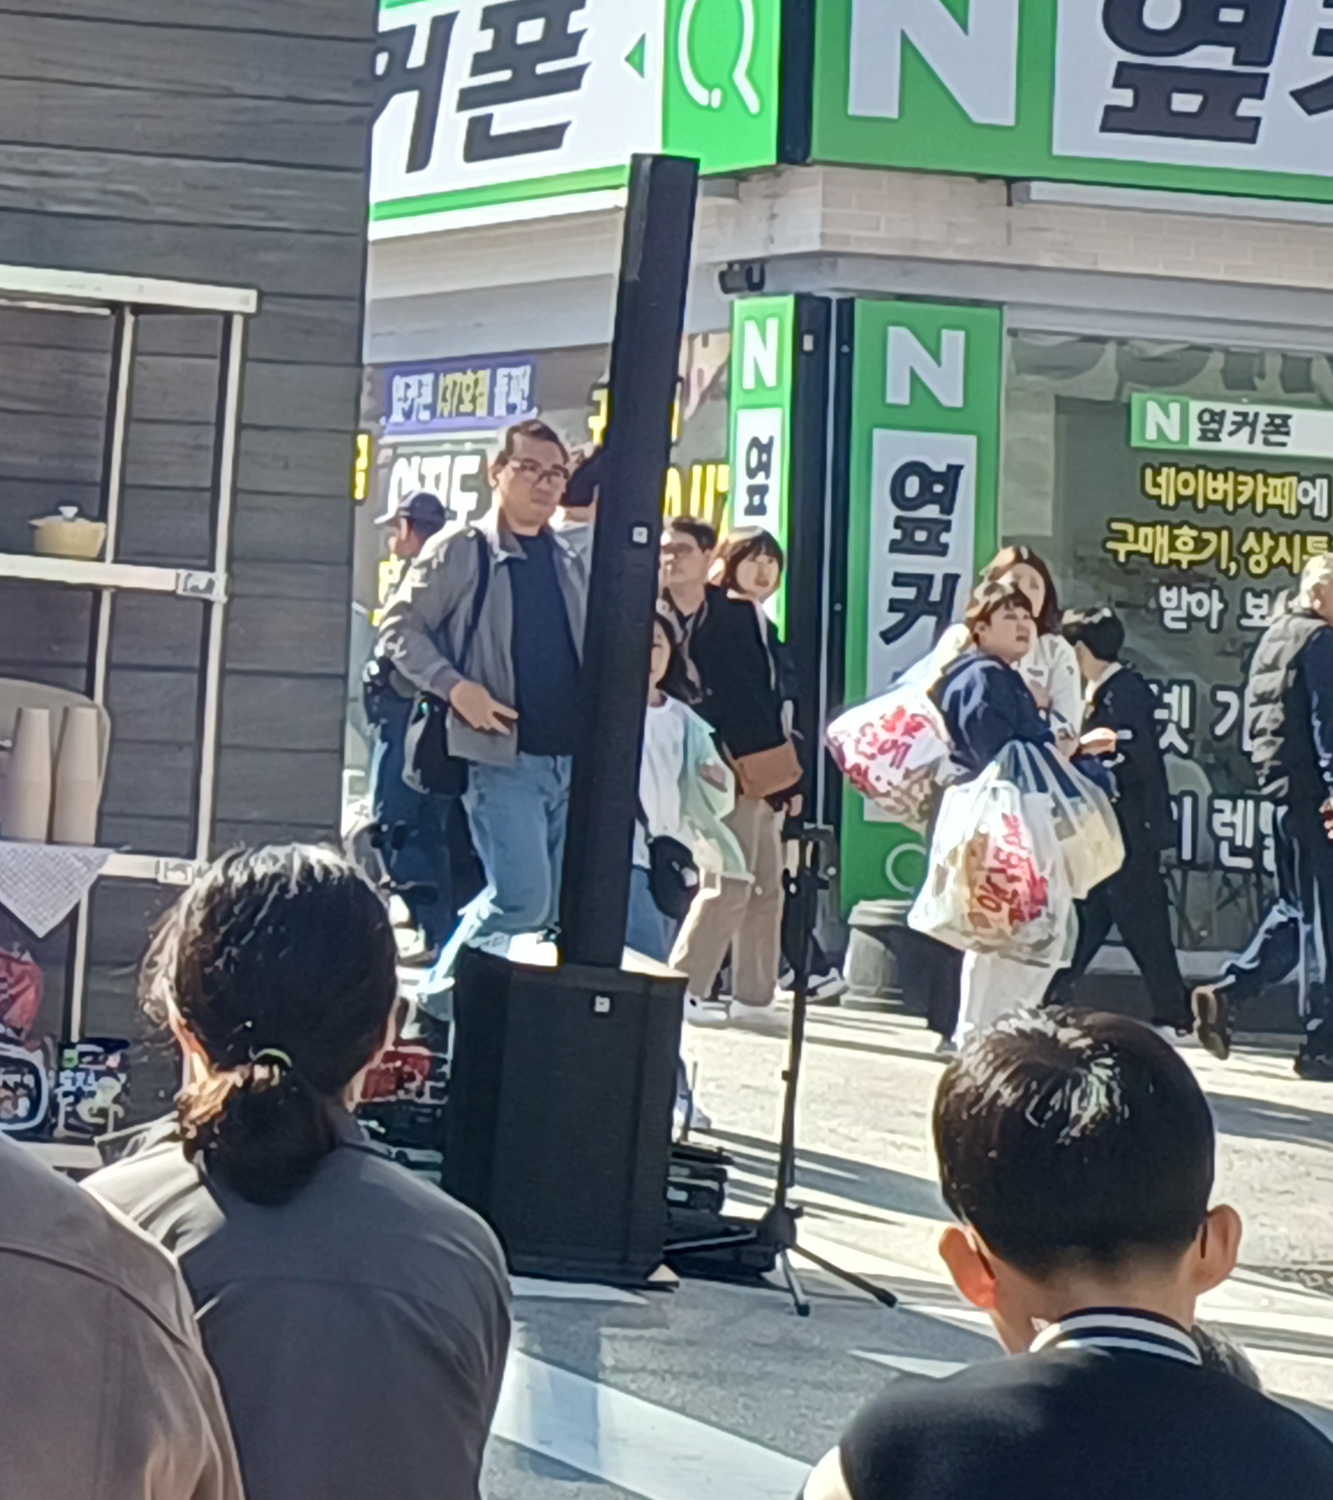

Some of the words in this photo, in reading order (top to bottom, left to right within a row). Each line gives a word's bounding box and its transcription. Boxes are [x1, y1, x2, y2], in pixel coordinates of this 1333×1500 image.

[741, 317, 779, 391] N
[885, 325, 966, 408] N
[1144, 399, 1182, 442] N
[1196, 406, 1294, 448] 옆커폰
[743, 434, 775, 518] 옆
[1144, 466, 1329, 519] 네이버카페에
[1159, 585, 1225, 630] 받아
